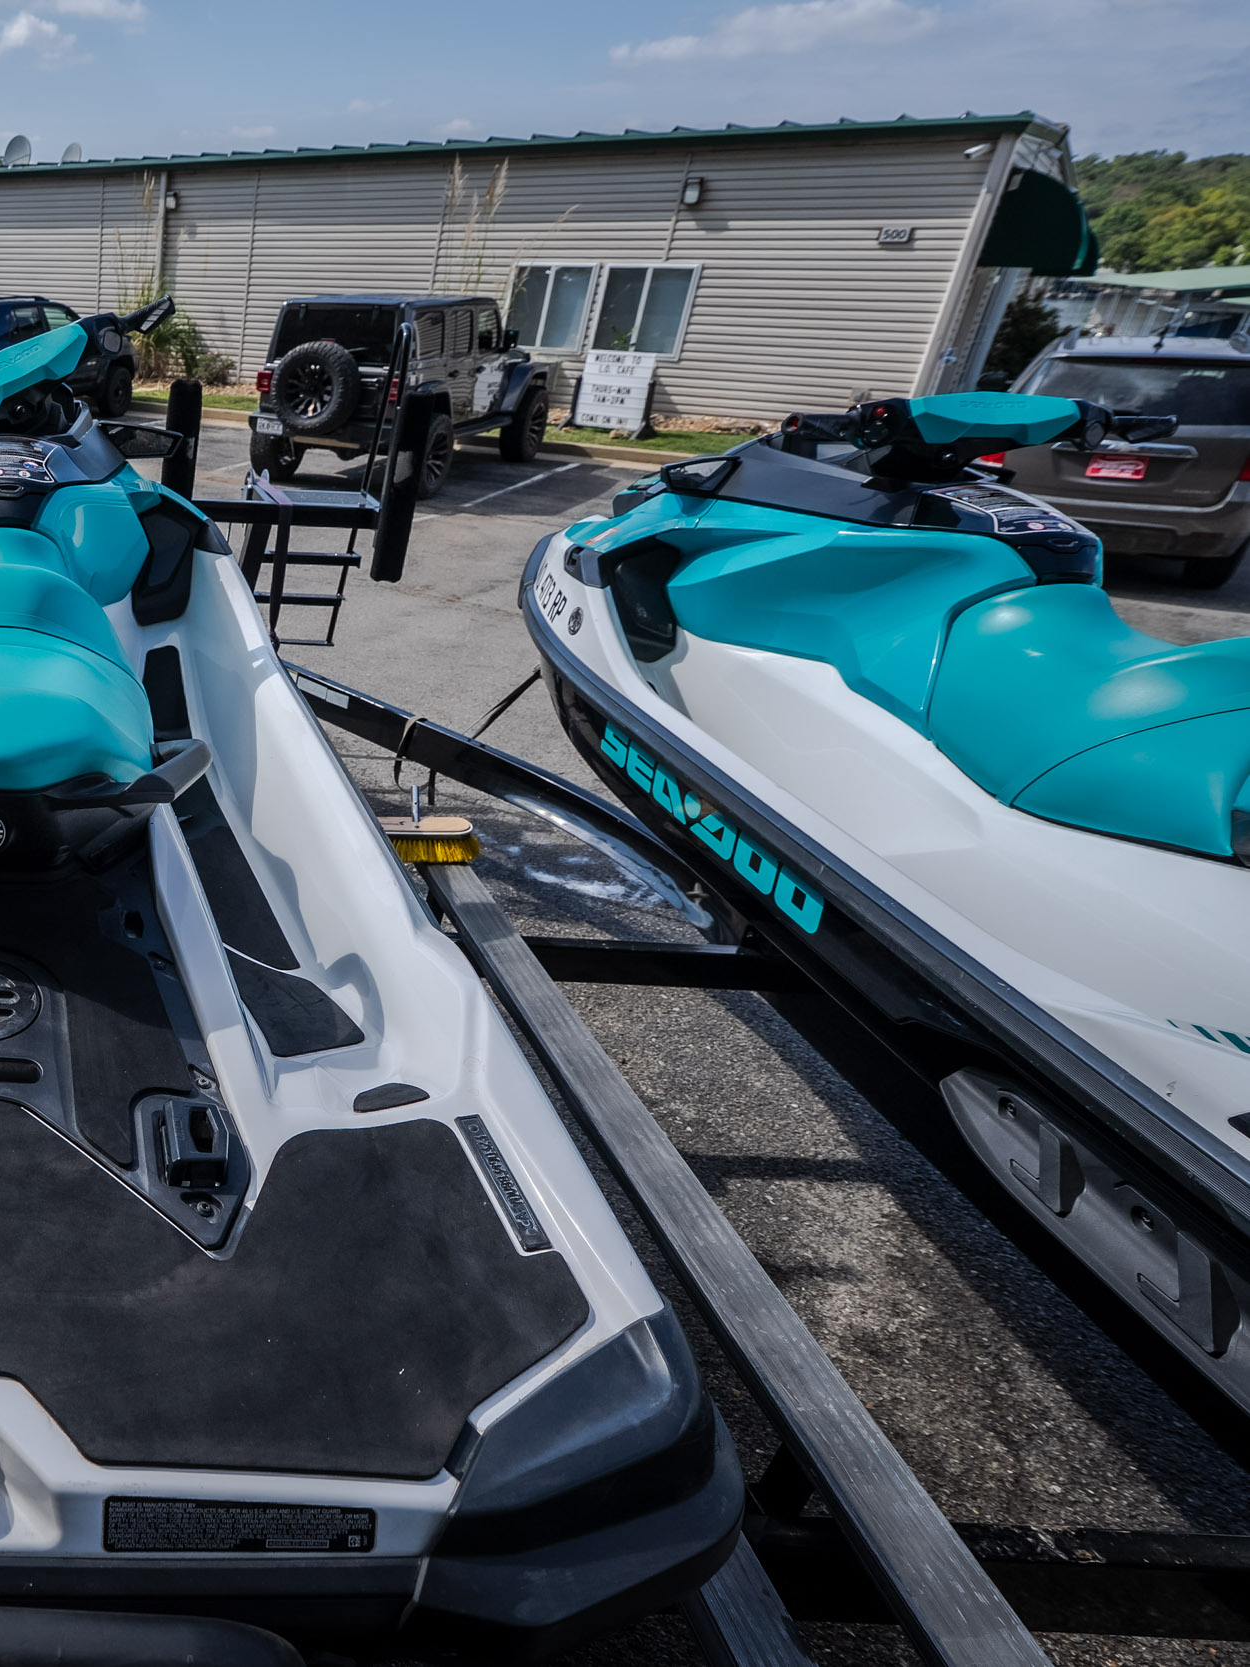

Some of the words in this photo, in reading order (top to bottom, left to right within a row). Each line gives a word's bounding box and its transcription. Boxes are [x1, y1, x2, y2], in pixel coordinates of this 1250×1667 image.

[883, 229, 907, 240] 500
[595, 353, 627, 365] WELCOME
[632, 355, 642, 365] TO
[616, 366, 636, 376] CAFE
[580, 413, 599, 424] COME
[602, 415, 612, 425] ON
[547, 589, 568, 623] RP
